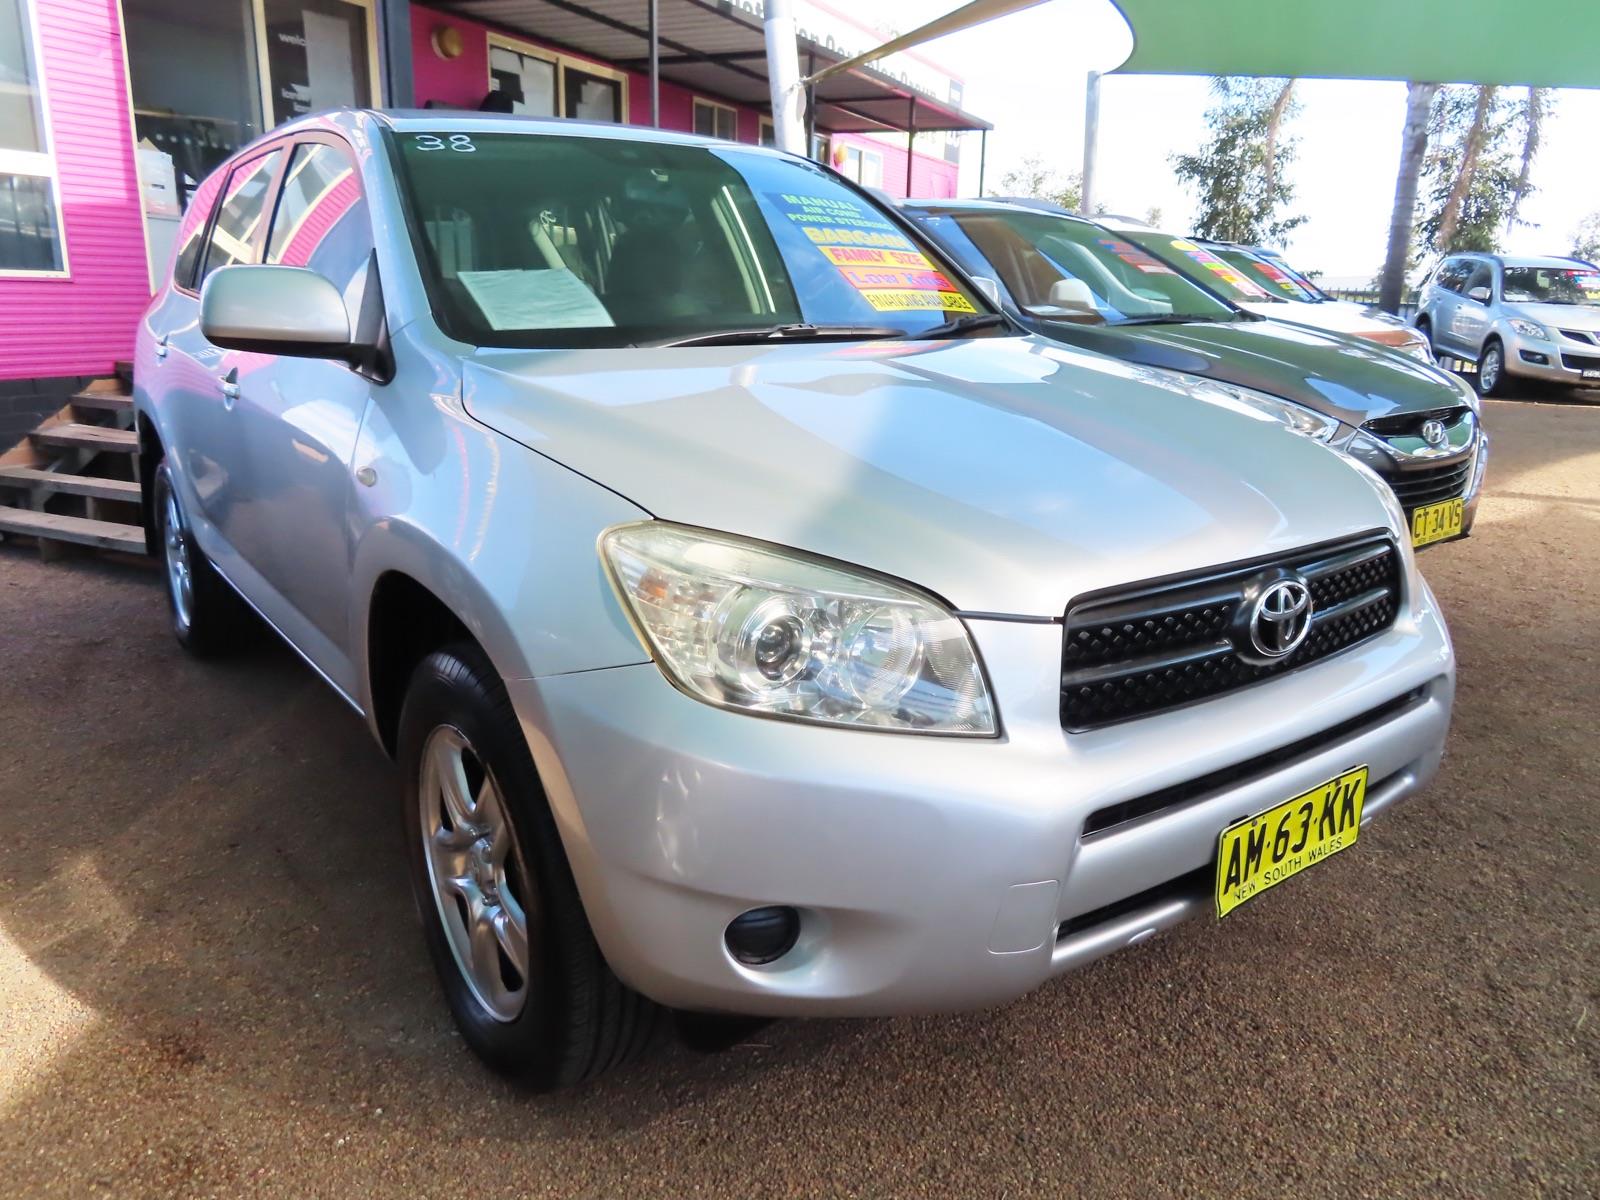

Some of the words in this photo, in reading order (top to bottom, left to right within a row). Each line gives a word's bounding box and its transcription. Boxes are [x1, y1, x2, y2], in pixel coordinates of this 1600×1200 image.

[416, 134, 477, 153] 38
[781, 194, 862, 212] MANUAL
[829, 247, 886, 264] FAMILY
[892, 252, 924, 266] SIZE
[1233, 881, 1257, 902] NEW
[1263, 856, 1303, 885] SOUTH
[1308, 836, 1344, 863] WALES
